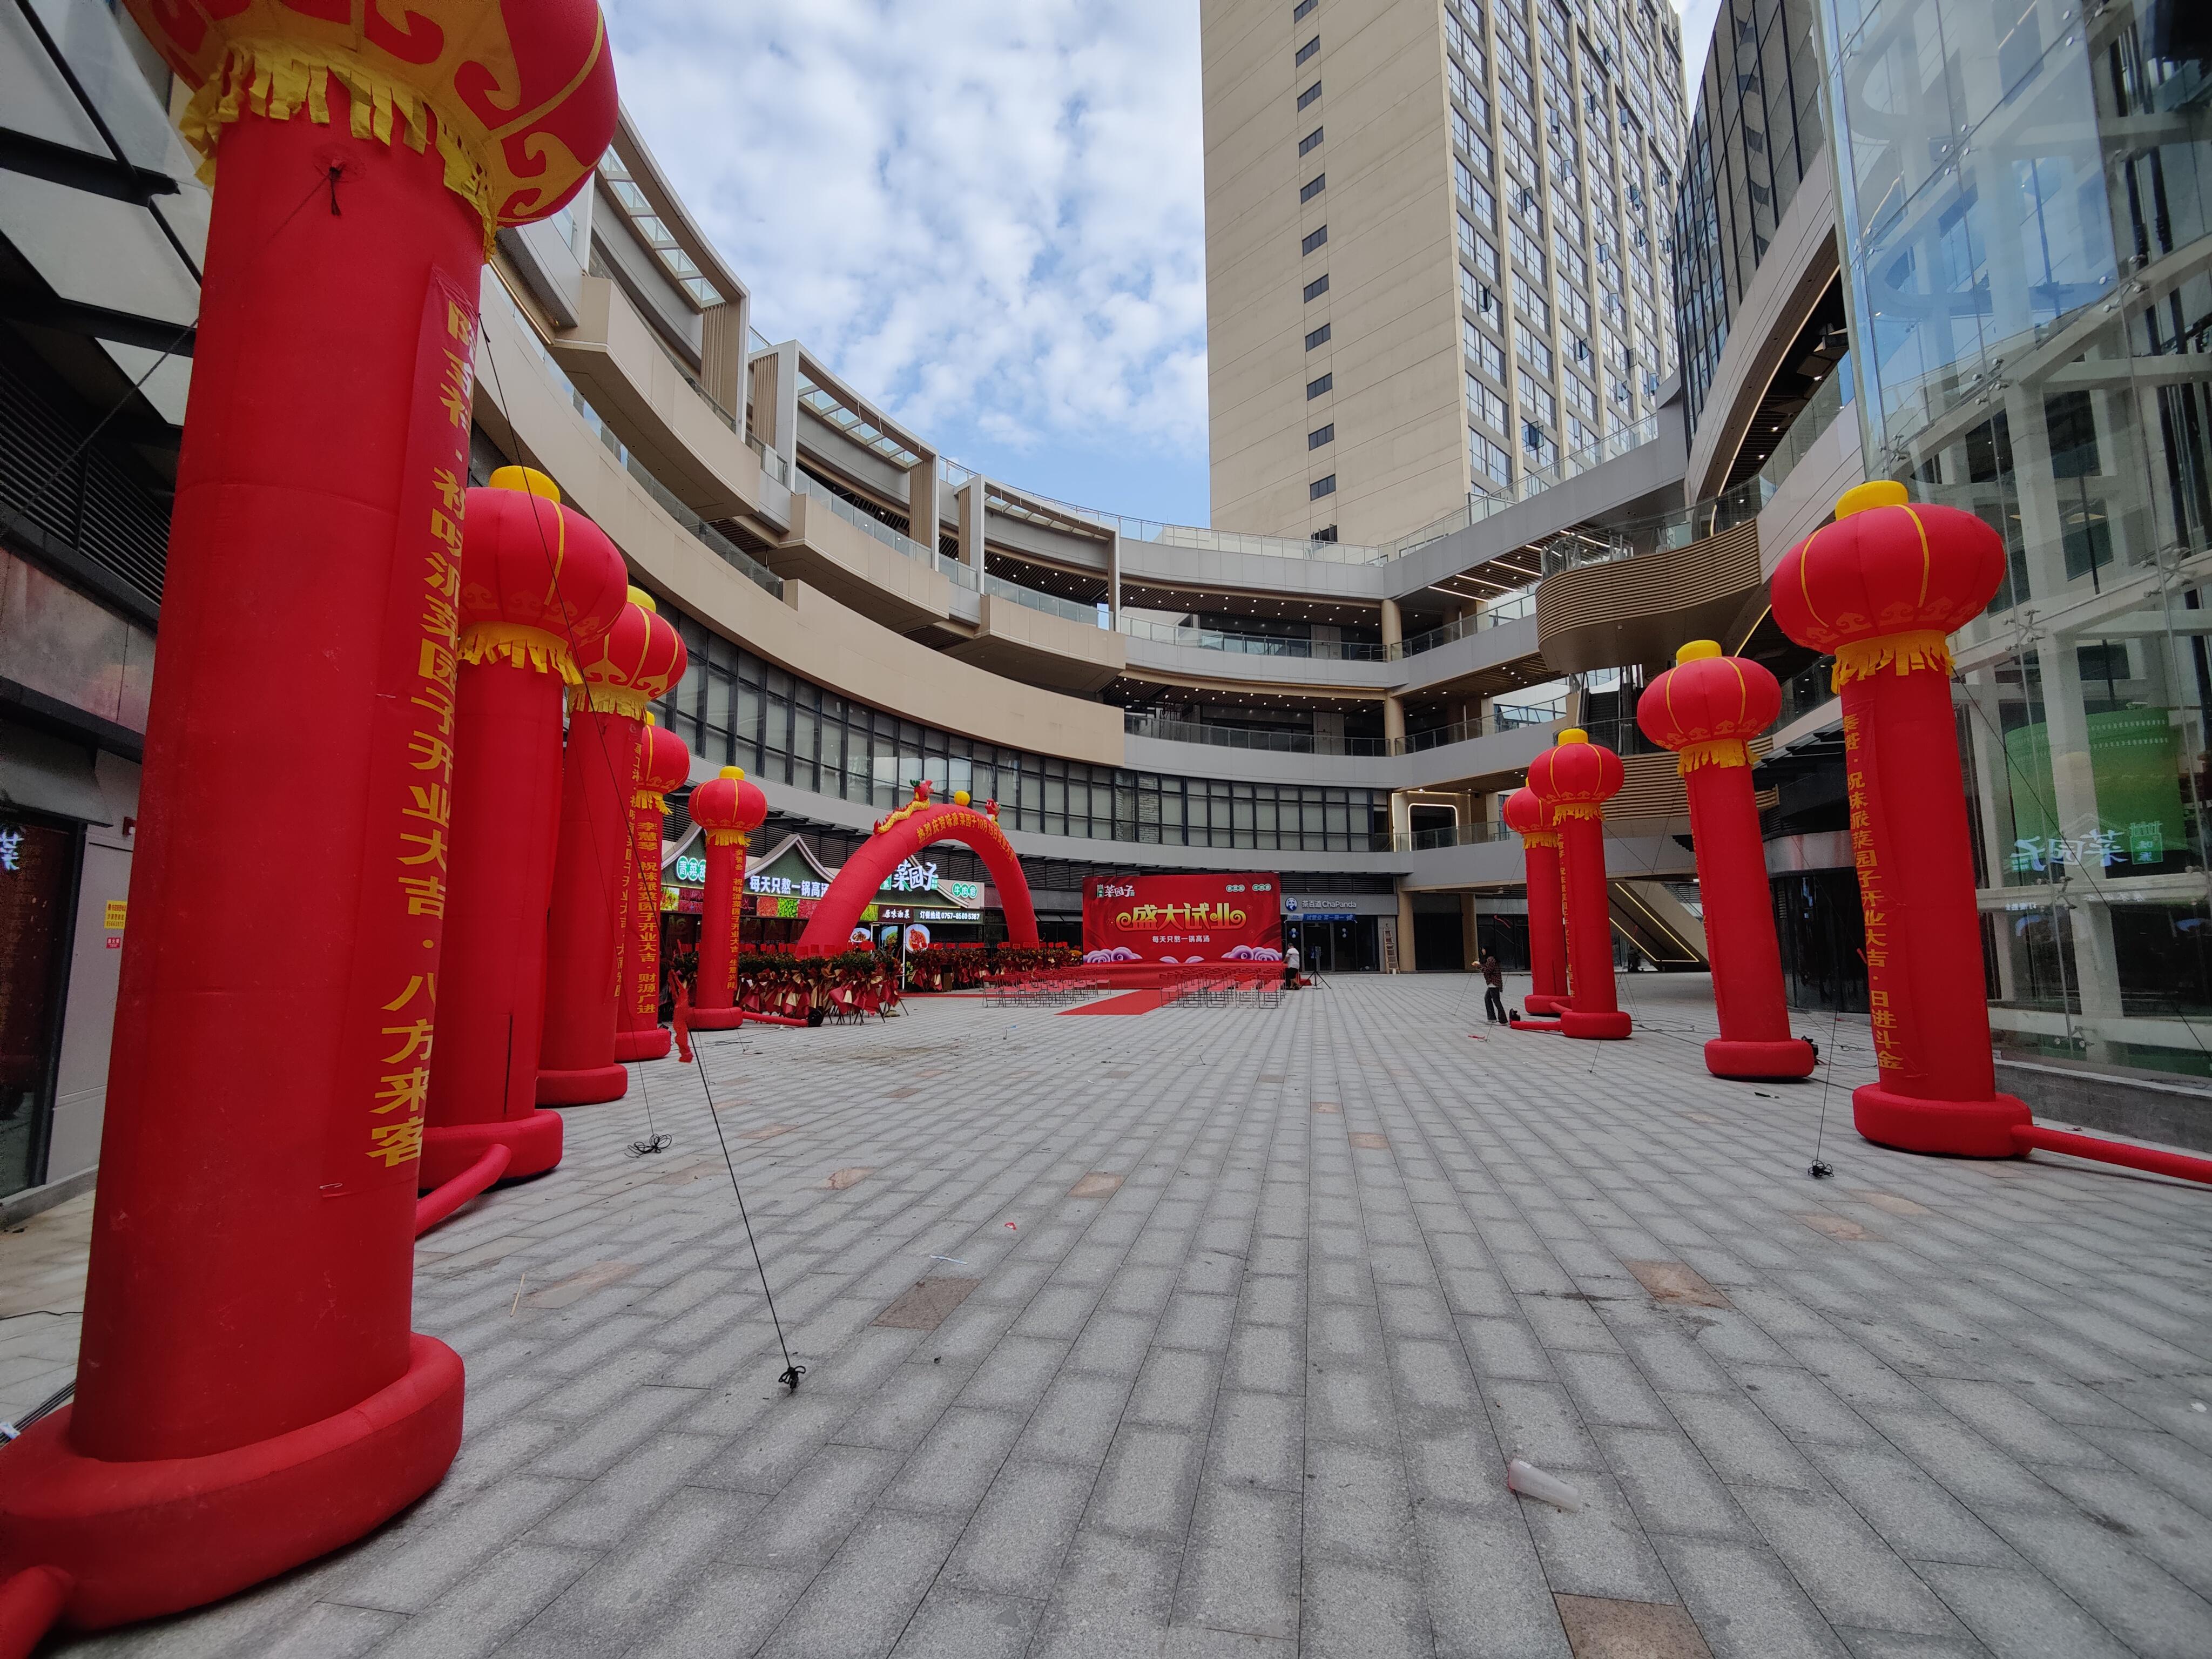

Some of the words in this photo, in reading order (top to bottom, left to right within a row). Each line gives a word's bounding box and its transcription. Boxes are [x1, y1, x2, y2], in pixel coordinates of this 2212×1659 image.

[892, 859, 938, 892] 菜园子
[1116, 902, 1246, 931] 盛大试业
[1301, 900, 1322, 908] 茶百道
